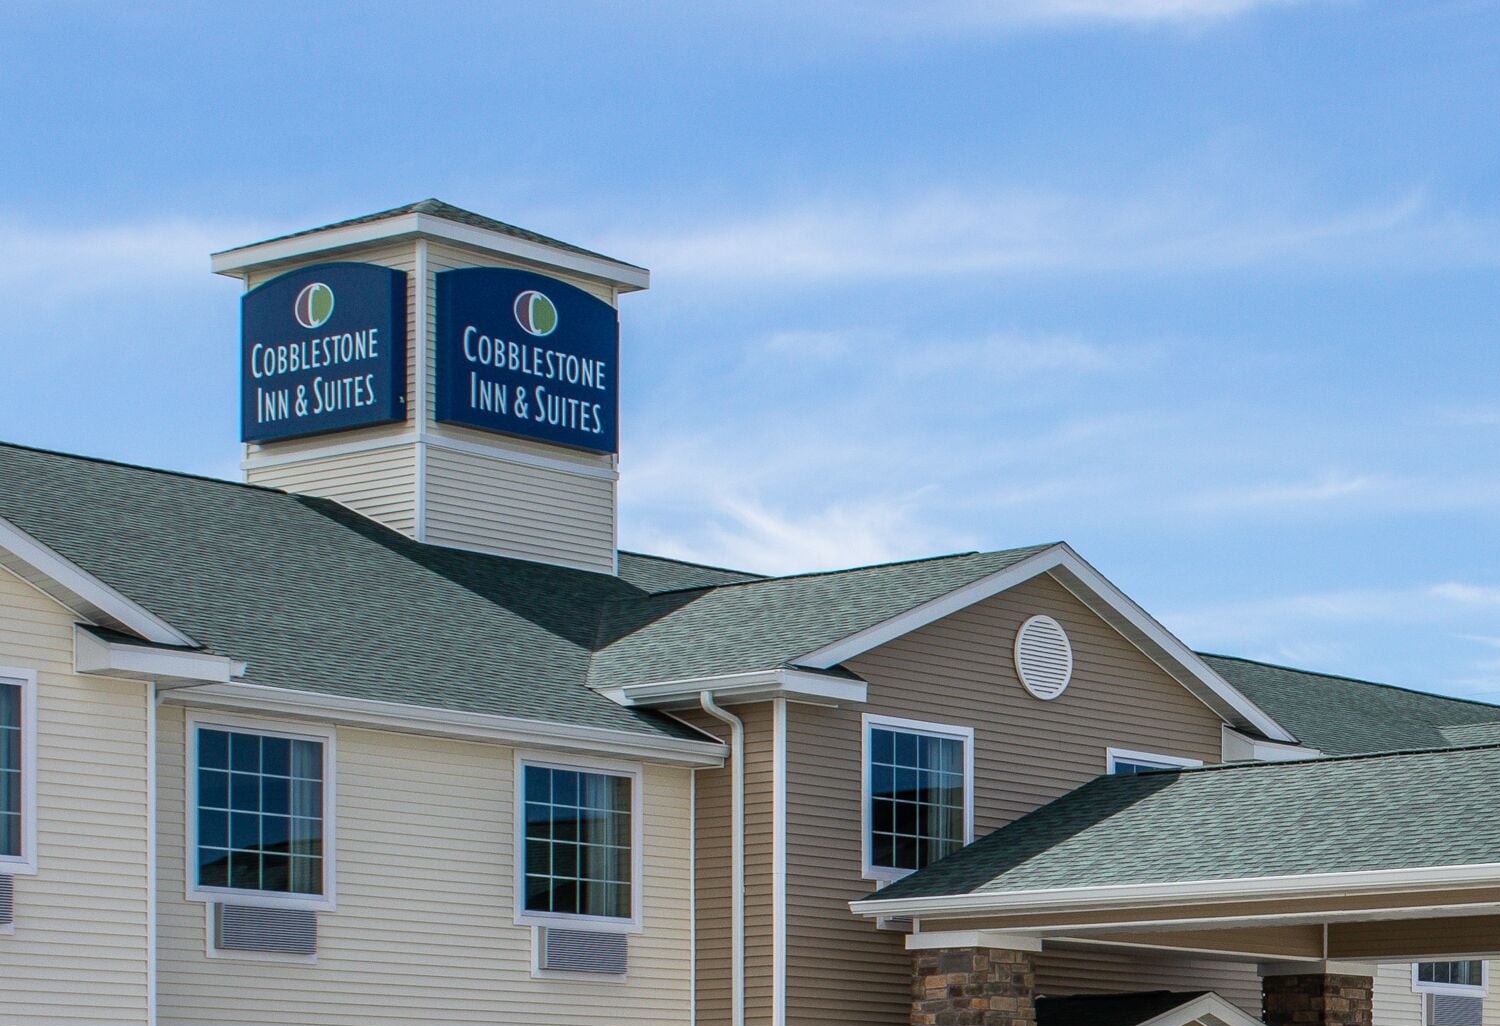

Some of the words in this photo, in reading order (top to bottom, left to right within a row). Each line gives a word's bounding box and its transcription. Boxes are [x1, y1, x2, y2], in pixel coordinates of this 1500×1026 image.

[251, 328, 379, 379] COBBLESTONE
[463, 325, 606, 390] COBBLESTONE
[257, 387, 289, 424] INN
[294, 384, 309, 417] &
[313, 374, 375, 415] SUITES
[470, 371, 507, 415] INN
[514, 386, 529, 420] &
[535, 385, 602, 434] SUITES
